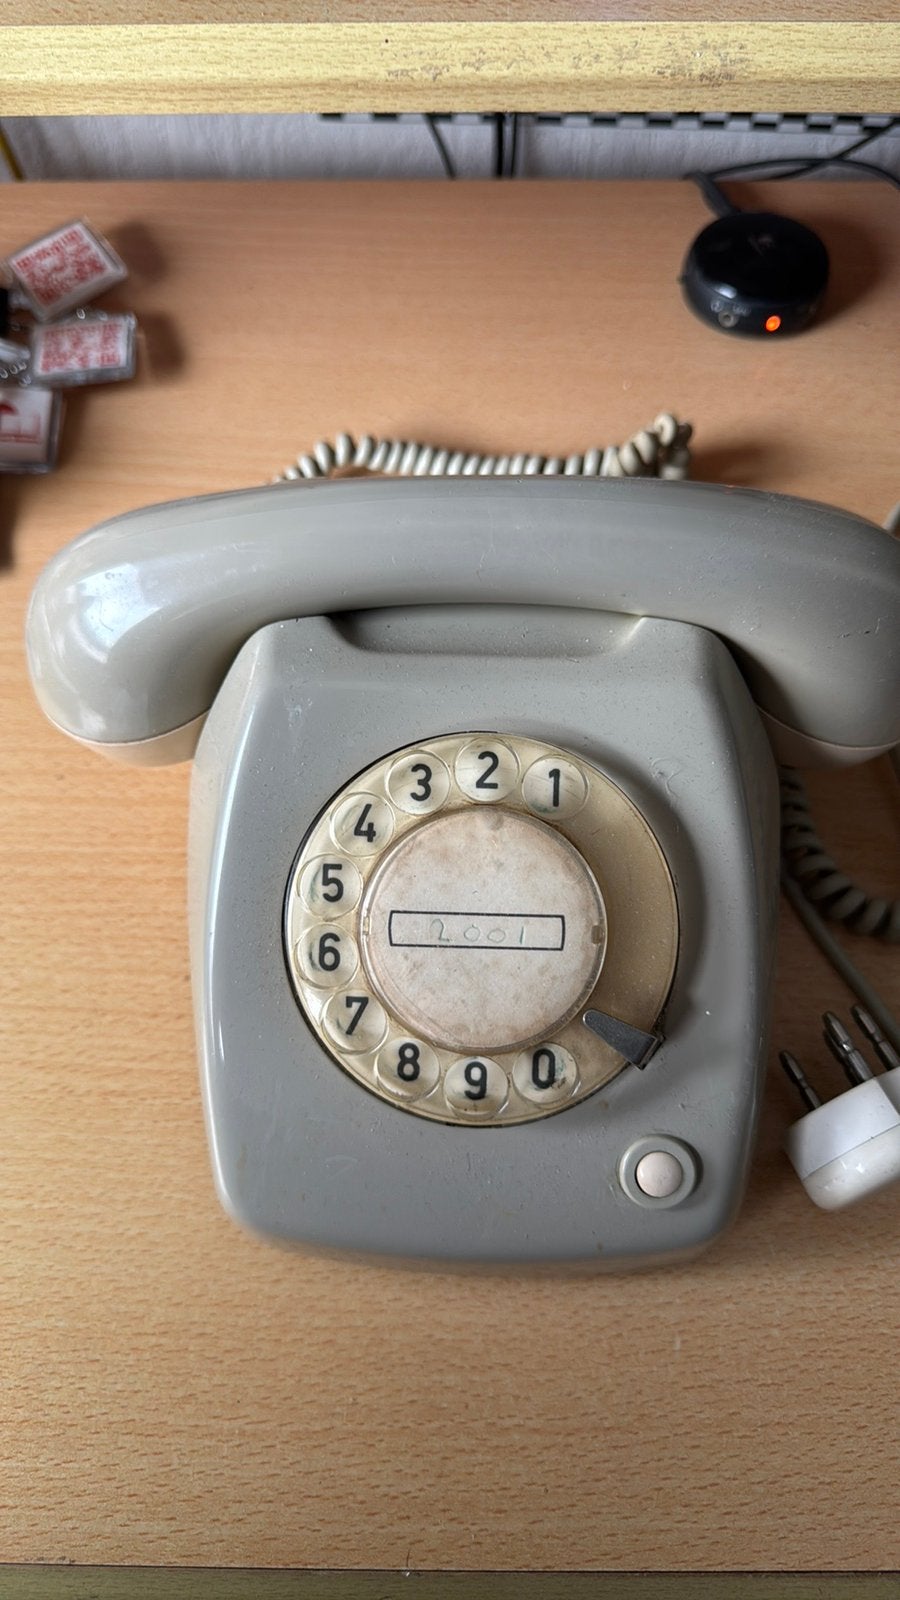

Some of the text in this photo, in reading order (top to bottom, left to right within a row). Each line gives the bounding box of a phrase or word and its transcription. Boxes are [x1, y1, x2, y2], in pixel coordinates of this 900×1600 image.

[410, 763, 433, 802] 3
[475, 750, 499, 790] 2
[548, 768, 561, 809] 1
[353, 803, 377, 843] 4
[322, 863, 344, 903] 5
[430, 918, 525, 944] 2001
[318, 932, 341, 972] 6
[345, 995, 370, 1036] 7
[396, 1042, 421, 1083] 8
[464, 1061, 488, 1101] 9
[531, 1047, 556, 1089] 0
